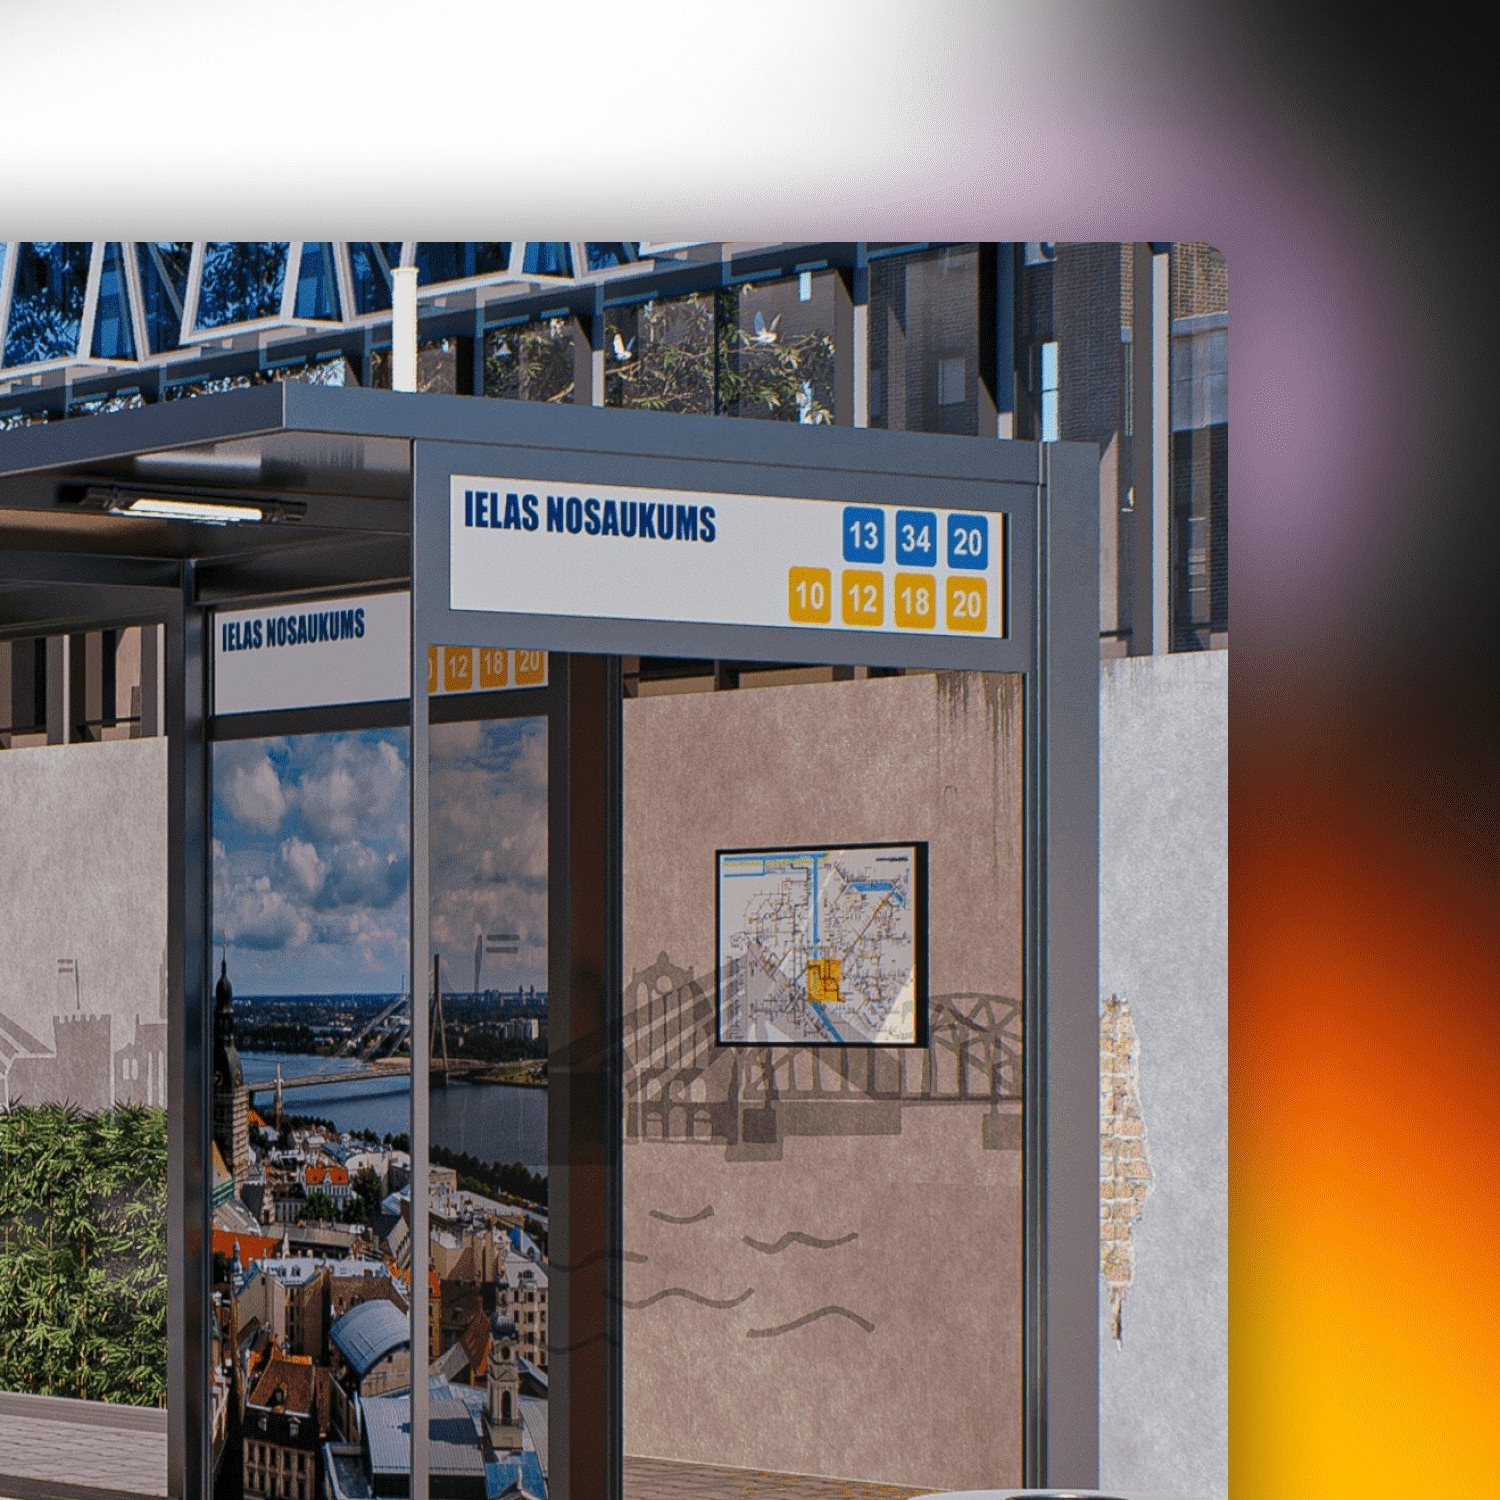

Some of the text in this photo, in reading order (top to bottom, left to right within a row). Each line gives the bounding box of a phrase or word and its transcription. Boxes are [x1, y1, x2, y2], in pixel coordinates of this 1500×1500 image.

[464, 490, 717, 543] IELAS NOSAUKUMS
[850, 520, 983, 557] 13 34 20
[796, 581, 981, 619] 10 12 18 20
[222, 607, 366, 653] IELAS NOSAUKUMS
[449, 655, 468, 679] 12
